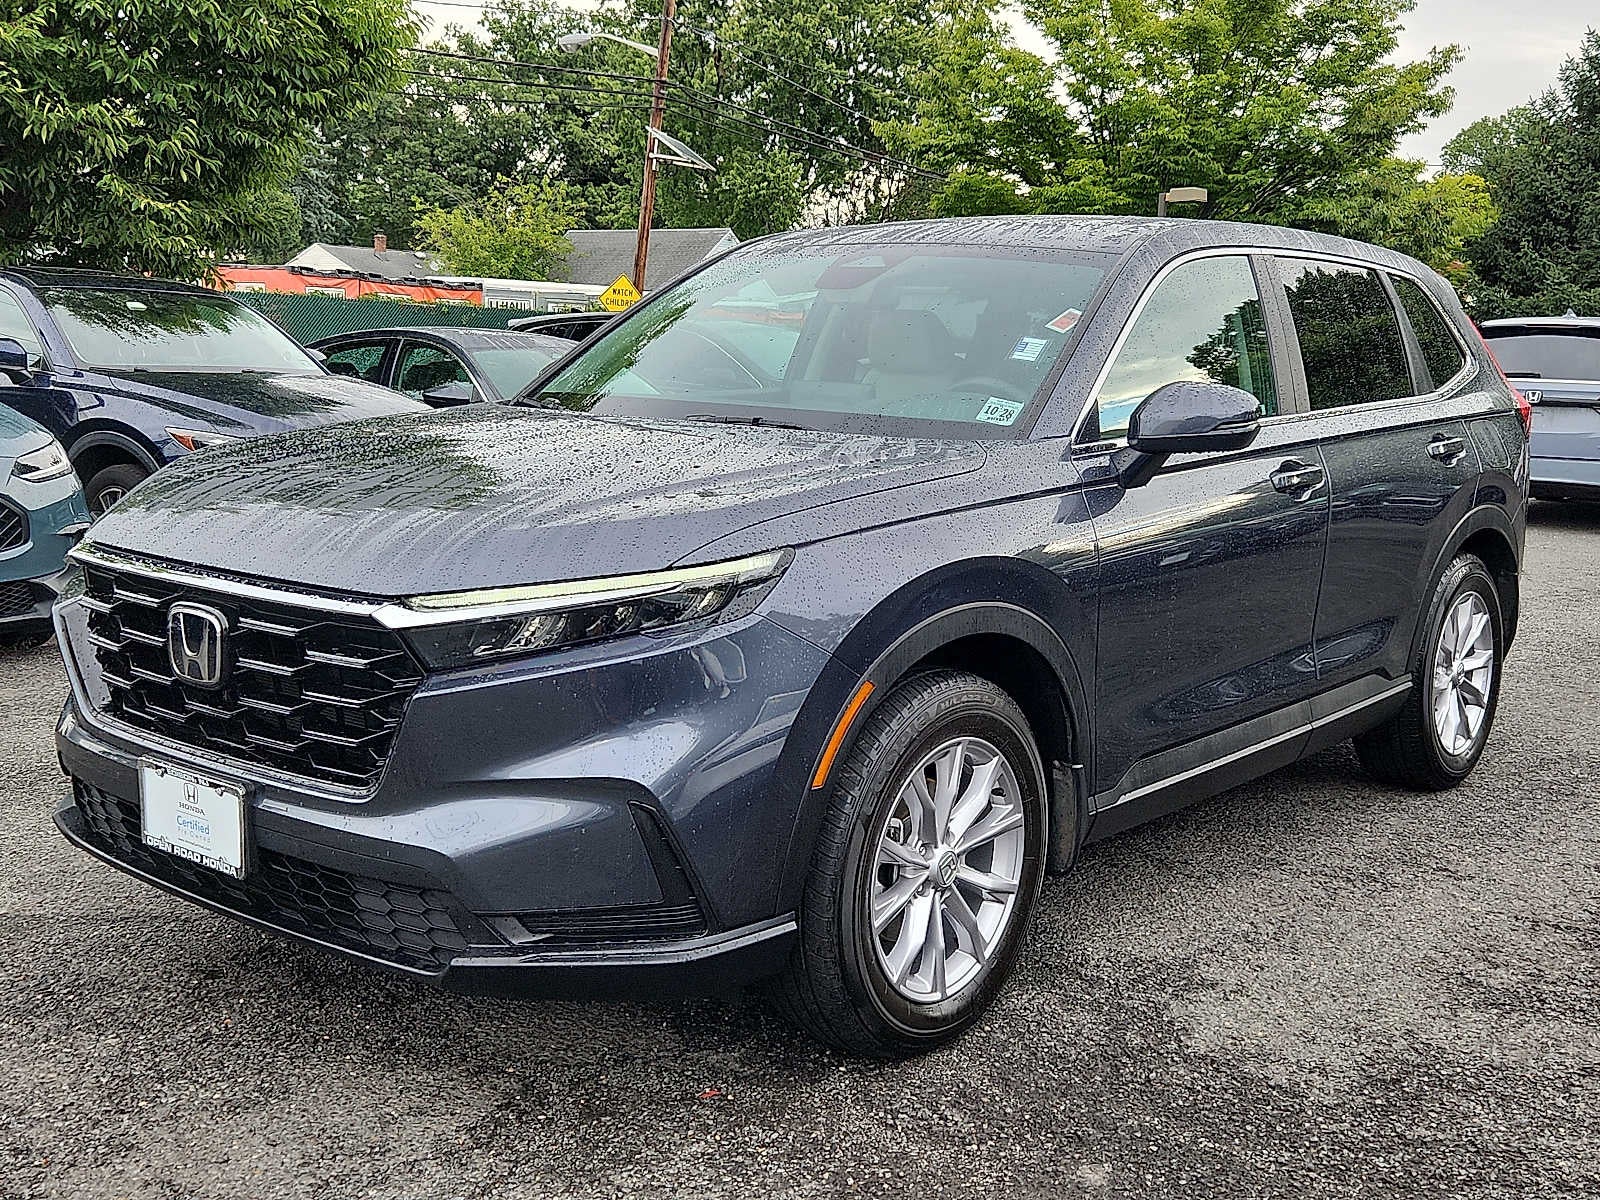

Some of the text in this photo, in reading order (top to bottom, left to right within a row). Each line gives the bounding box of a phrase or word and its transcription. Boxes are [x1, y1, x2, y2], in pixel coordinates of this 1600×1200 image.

[612, 288, 634, 297] WATCH
[983, 404, 999, 415] 10
[999, 408, 1015, 419] 28
[178, 801, 205, 815] HONDA
[176, 815, 210, 834] Certified
[147, 835, 172, 853] OPEN
[174, 846, 201, 863] ROAD
[202, 855, 238, 879] HONDA
